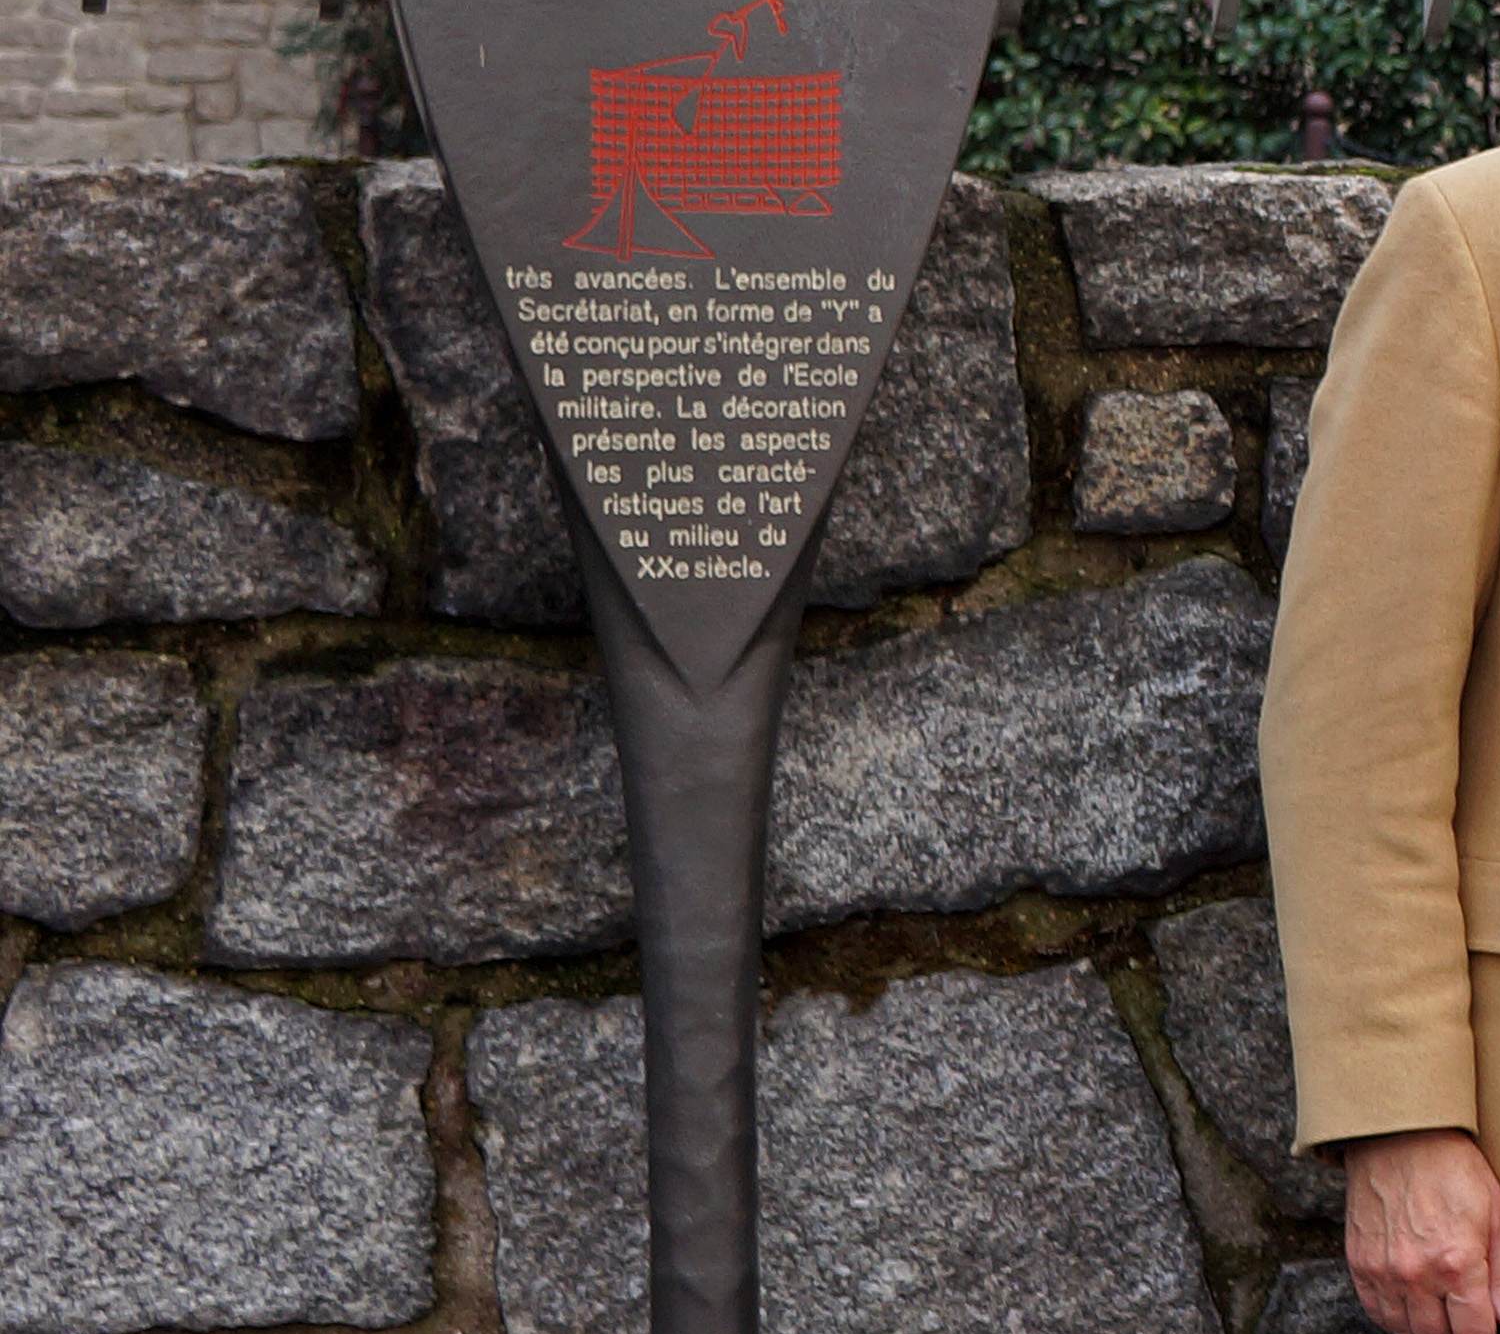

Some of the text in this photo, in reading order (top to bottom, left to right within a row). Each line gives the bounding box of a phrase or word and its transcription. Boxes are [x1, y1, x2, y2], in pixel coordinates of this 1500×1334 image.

[505, 265, 896, 293] très avancées. L'ensemble du
[517, 297, 660, 326] Secrétariat,
[667, 305, 698, 323] en
[706, 298, 774, 324] forme
[783, 298, 812, 324] de
[868, 306, 882, 324] a
[529, 331, 870, 361] été conçu pour s'intégrer dans
[543, 363, 859, 393] la perspective de l'Ecole
[557, 395, 846, 419] militaire. La décoration
[572, 428, 831, 458] présente les aspects
[586, 460, 817, 489] les plus caracté-
[602, 492, 802, 517] ristiques de l'art
[619, 523, 787, 548] au milieu du
[637, 554, 771, 580] XXe siècle.
